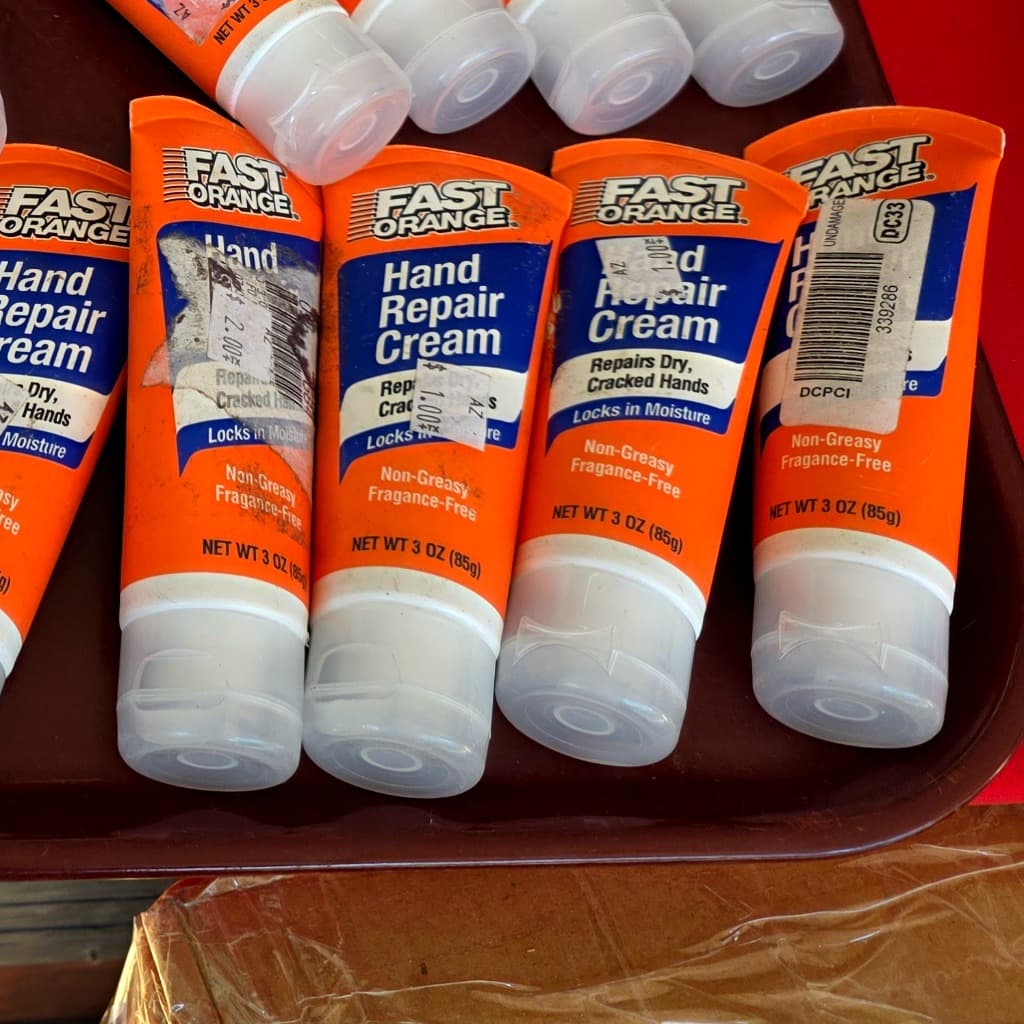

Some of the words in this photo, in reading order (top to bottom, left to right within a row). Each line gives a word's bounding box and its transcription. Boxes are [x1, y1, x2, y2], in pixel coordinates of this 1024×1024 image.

[184, 147, 285, 193] FAST
[4, 184, 131, 225] FAST
[185, 182, 294, 218] ORANGE
[374, 179, 514, 217] FAST
[601, 176, 746, 206] FAST
[370, 208, 509, 239] ORANGE
[595, 201, 741, 226] ORANGE
[880, 202, 906, 239] DC33
[204, 234, 279, 274] Hand
[645, 245, 675, 272] 1.00
[383, 254, 480, 294] Hand
[379, 287, 505, 329] Repair
[876, 284, 898, 334] 339286
[222, 315, 244, 357] 2.00
[588, 310, 719, 345] Cream
[376, 327, 502, 366] Cream
[416, 390, 445, 424] 1.00
[800, 386, 850, 398] DCPCI
[584, 439, 674, 476] Non-Greasy
[792, 432, 882, 452] Non-Greasy
[571, 457, 681, 499] Fragance-Free
